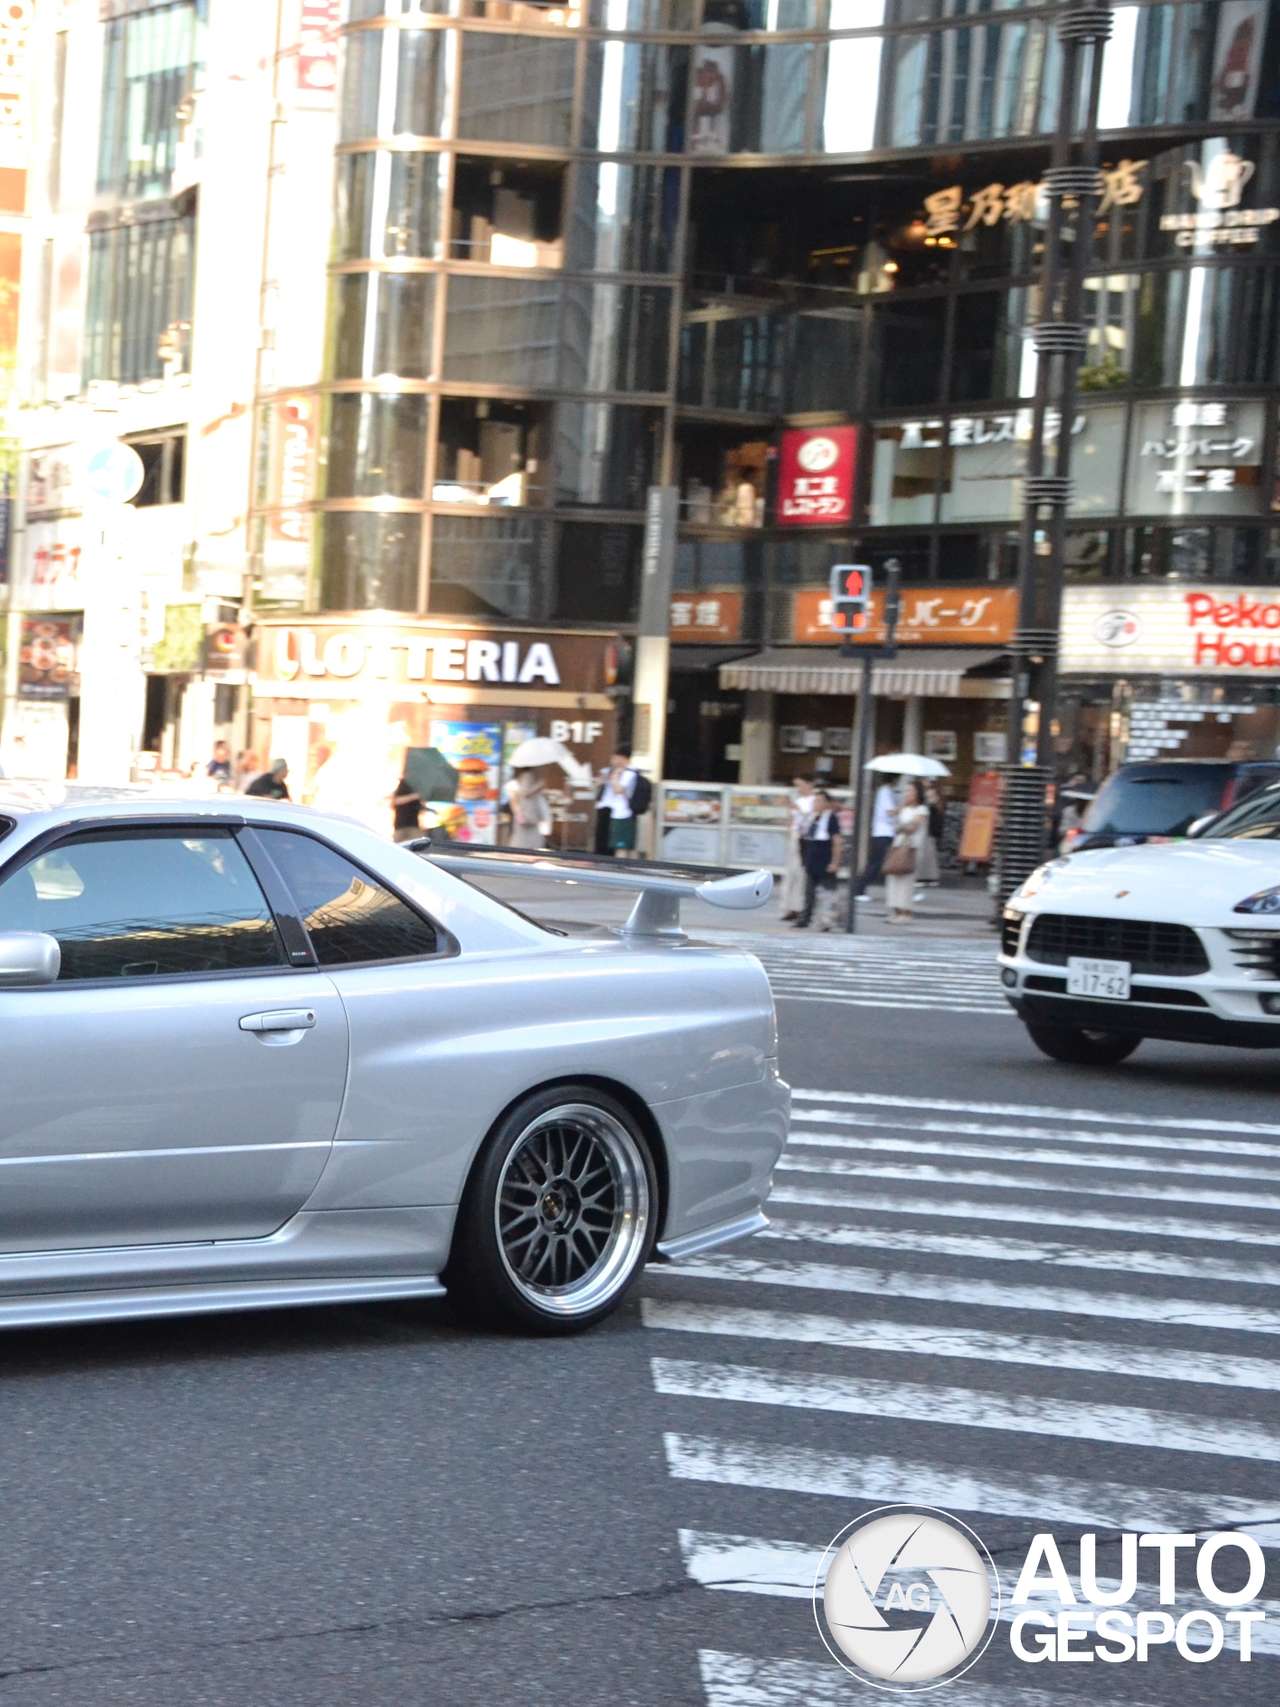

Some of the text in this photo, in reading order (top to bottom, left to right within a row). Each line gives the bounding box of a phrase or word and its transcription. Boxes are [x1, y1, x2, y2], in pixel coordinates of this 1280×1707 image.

[924, 159, 1149, 236] 星乃珈店
[1183, 592, 1280, 629] Peko
[300, 633, 560, 685] LOTTERIA
[549, 721, 603, 744] B1F
[1082, 974, 1126, 996] 17-62
